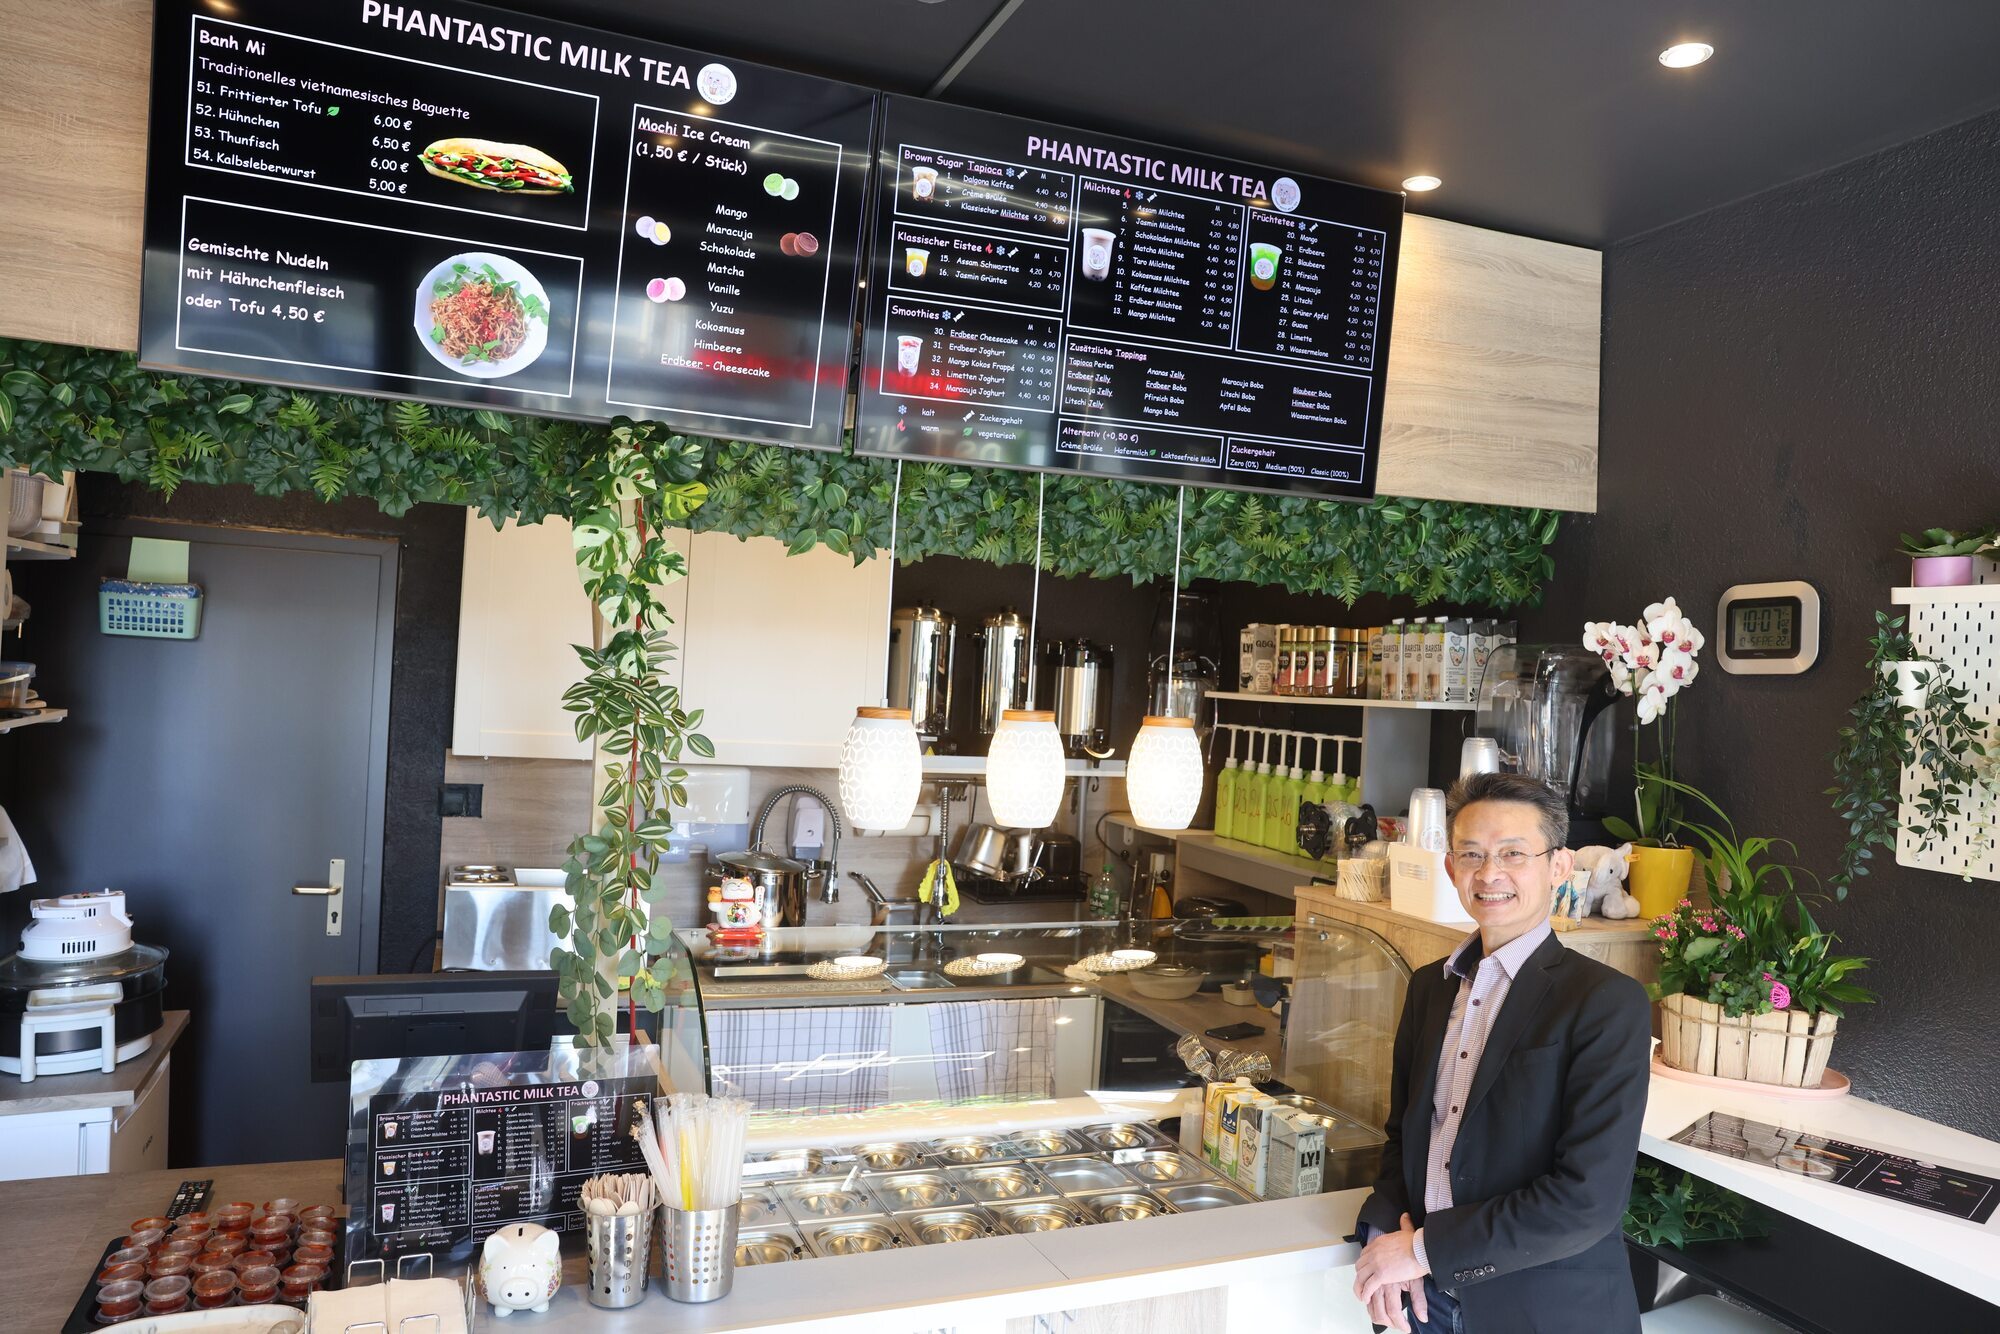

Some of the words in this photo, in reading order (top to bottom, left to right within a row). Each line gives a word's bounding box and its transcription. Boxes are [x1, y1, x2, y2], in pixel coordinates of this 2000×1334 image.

[200, 29, 239, 51] Banh
[245, 39, 266, 56] Mi
[362, 0, 552, 61] PHANTASTIC
[560, 41, 632, 78] MILK
[639, 57, 690, 90] TEA
[198, 56, 296, 87] Traditionelles
[300, 78, 408, 108] vietnamesisches
[412, 98, 470, 120] Baguette
[197, 80, 215, 95] 51.
[220, 85, 289, 108] Frittierter
[292, 99, 322, 115] Tofu
[374, 114, 401, 129] 6,00
[403, 120, 413, 131] €
[195, 103, 216, 117] 52.
[219, 107, 280, 129] Hühnchen
[372, 136, 399, 150] 6,50
[401, 141, 411, 152] €
[638, 117, 678, 137] Mochi
[682, 125, 705, 141] Ice
[710, 131, 751, 150] Cream
[194, 125, 214, 140] 53.
[218, 129, 280, 151] Thunfisch
[370, 157, 397, 171] 6,00
[400, 162, 409, 173] €
[636, 141, 673, 160] (1,50
[677, 150, 688, 162] €
[692, 153, 701, 164] /
[705, 155, 747, 176] Stück)
[904, 149, 932, 163] Brown
[936, 155, 964, 169] Sugar
[967, 160, 1003, 176] Tapioca
[193, 148, 213, 162] 54.
[216, 152, 316, 179] Kalbsleberwurst
[369, 178, 396, 192] 5,00
[398, 183, 408, 194] €
[1027, 136, 1166, 181] PHANTASTIC
[1171, 163, 1224, 192] MILK
[1229, 174, 1266, 200] TEA
[1083, 181, 1121, 196] Milchtee
[715, 204, 748, 221] Mango
[1252, 211, 1295, 227] Früchtetee
[706, 222, 753, 241] Maracuja
[1287, 231, 1296, 239] 20.
[1300, 234, 1318, 245] Mango
[699, 241, 756, 259] Schokolade
[898, 231, 950, 247] Klassischer
[953, 239, 982, 252] Eistee
[188, 237, 269, 262] Gemischte
[276, 250, 329, 271] Nudeln
[1286, 244, 1294, 252] 21.
[1299, 246, 1325, 257] Erdbeere
[707, 262, 744, 277] Matcha
[940, 254, 950, 263] 15.
[956, 257, 979, 267] Assam
[979, 260, 1020, 273] Schwarztee
[1048, 270, 1062, 278] 4,70
[1284, 256, 1294, 264] 22.
[1297, 258, 1325, 270] Blaubeere
[187, 267, 213, 280] mit
[220, 269, 344, 300] Hähnchenfleisch
[939, 268, 949, 277] 16.
[955, 270, 979, 281] Jasmin
[980, 274, 1008, 285] Grüntee
[1047, 283, 1060, 291] 4,70
[1283, 269, 1293, 277] 23.
[1296, 271, 1318, 281] Pfirsich
[708, 281, 740, 296] Vanille
[1282, 281, 1291, 289] 24.
[1295, 284, 1321, 296] Maracuja
[710, 301, 734, 314] Yuzu
[1281, 293, 1290, 301] 25.
[1294, 296, 1313, 305] Litschi
[185, 293, 222, 309] oder
[228, 298, 265, 315] Tofu
[271, 304, 308, 321] 4,50
[313, 310, 325, 323] €
[891, 305, 940, 320] Smoothies
[1280, 306, 1289, 314] 26.
[1293, 308, 1313, 317] Grüner
[1313, 312, 1329, 321] Apfel
[695, 319, 745, 335] Kokosnuss
[1291, 321, 1308, 330] Guave
[934, 327, 945, 335] 30.
[950, 329, 978, 341] Erdbeer
[980, 333, 1018, 345] Cheesecake
[1277, 331, 1287, 339] 28.
[1290, 333, 1312, 343] Limette
[694, 339, 742, 354] Himbeere
[933, 341, 942, 349] 31.
[949, 343, 977, 353] Erdbeer
[978, 347, 1005, 357] Joghurt
[1069, 342, 1113, 356] Zusätzliche
[1115, 348, 1147, 362] Toppings
[1276, 343, 1285, 351] 29.
[1289, 345, 1329, 358] Wassermelone
[661, 354, 703, 370] Erdbeer
[713, 361, 770, 378] Cheesecake
[932, 355, 943, 363] 32.
[948, 357, 970, 368] Mango
[971, 360, 991, 369] Kokos
[992, 362, 1015, 373] Frappé
[931, 368, 941, 376] 33.
[947, 371, 977, 381] Limetten
[978, 374, 1005, 385] Joghurt
[930, 382, 940, 390] 34.
[946, 384, 977, 396] Maracuja
[978, 388, 1005, 398] Joghurt
[922, 408, 935, 416] kalt
[979, 414, 1023, 425] Zuckergehalt
[921, 425, 940, 433] warm
[1062, 427, 1100, 437] Alternativ
[1103, 431, 1128, 441] (+0,50
[1130, 434, 1139, 444] €)
[1231, 445, 1276, 457] Zuckergehalt
[1230, 459, 1244, 467] Zero
[1245, 461, 1259, 470] (0%)
[1265, 463, 1287, 471] Medium
[1288, 465, 1305, 475] (50%)
[1310, 468, 1329, 476] Classic
[1330, 470, 1349, 479] (100%)
[1743, 608, 1782, 633] 10:07
[1405, 644, 1421, 652] BARISTA
[1425, 644, 1442, 652] BARISTA
[443, 1089, 521, 1105] PHANTASTIC
[523, 1087, 554, 1100] MILK
[556, 1085, 580, 1097] TEA
[1300, 1151, 1320, 1168] LY!
[1853, 1145, 1886, 1157] MILK
[1889, 1154, 1913, 1164] TEA
